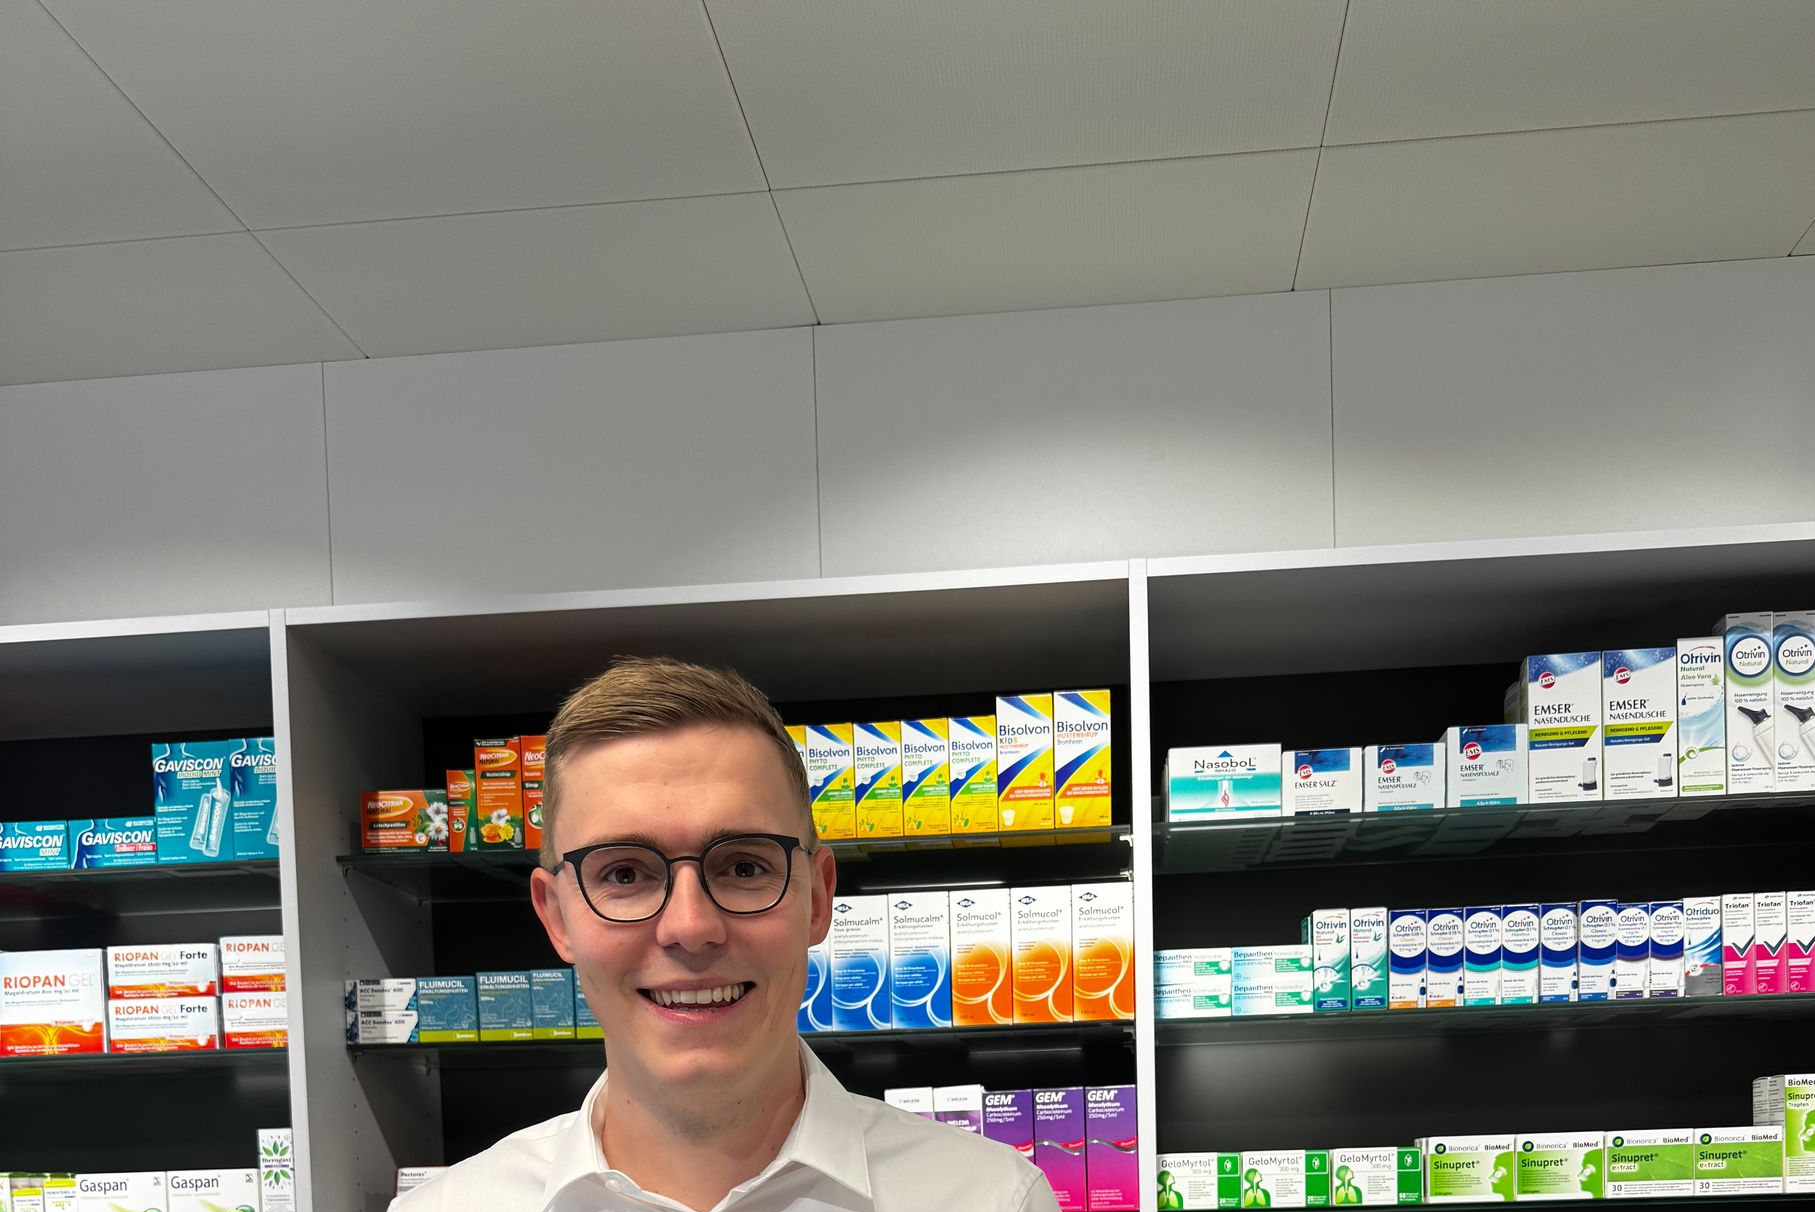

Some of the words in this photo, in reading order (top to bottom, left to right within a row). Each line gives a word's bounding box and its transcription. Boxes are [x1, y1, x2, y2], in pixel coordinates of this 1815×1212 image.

[1680, 652, 1721, 665] Otrivin
[1534, 703, 1571, 715] EMSER
[1609, 699, 1647, 711] EMSER
[1534, 714, 1591, 725] NASENDUSCHE
[1609, 710, 1667, 720] NASENDUSCHE
[999, 724, 1051, 737] Bisolvon
[1056, 720, 1108, 733] Bisolvon
[951, 740, 993, 751] Bisolvon
[999, 737, 1018, 745] KIDS
[809, 747, 850, 758] Bisolvon
[856, 746, 898, 756] Bisolvon
[904, 743, 945, 753] Bisolvon
[155, 758, 224, 773] GAVISCON
[231, 754, 277, 768] GAVISC
[1294, 781, 1317, 790] EMSER
[1318, 780, 1336, 788] SALZ
[0, 835, 63, 849] AVISCON
[81, 831, 152, 846] GAVISCON
[1017, 909, 1059, 919] Solmucol
[1078, 906, 1121, 916] Solmucol
[1685, 907, 1720, 916] Otriduo
[833, 918, 880, 927] Solmucalm
[893, 914, 941, 924] Solmucalm
[956, 912, 998, 922] Solmucol
[114, 951, 159, 962] RIOPAN
[180, 951, 208, 960] Forte
[4, 974, 66, 989] RIOPAN
[69, 973, 93, 987] GEL
[419, 980, 465, 989] FLUIMUCIL
[480, 975, 528, 984] FLUIMUCIL
[228, 999, 272, 1008] RIOPAN
[985, 1094, 1012, 1105] GEM
[1035, 1092, 1063, 1103] GEM
[1087, 1090, 1115, 1101] GEM
[1161, 1158, 1211, 1169] GeloMyrtol
[1434, 1160, 1475, 1171] Sinupret
[80, 1179, 128, 1195] Gaspan
[171, 1175, 219, 1192] Gaspan
[1612, 1184, 1623, 1192] 30
